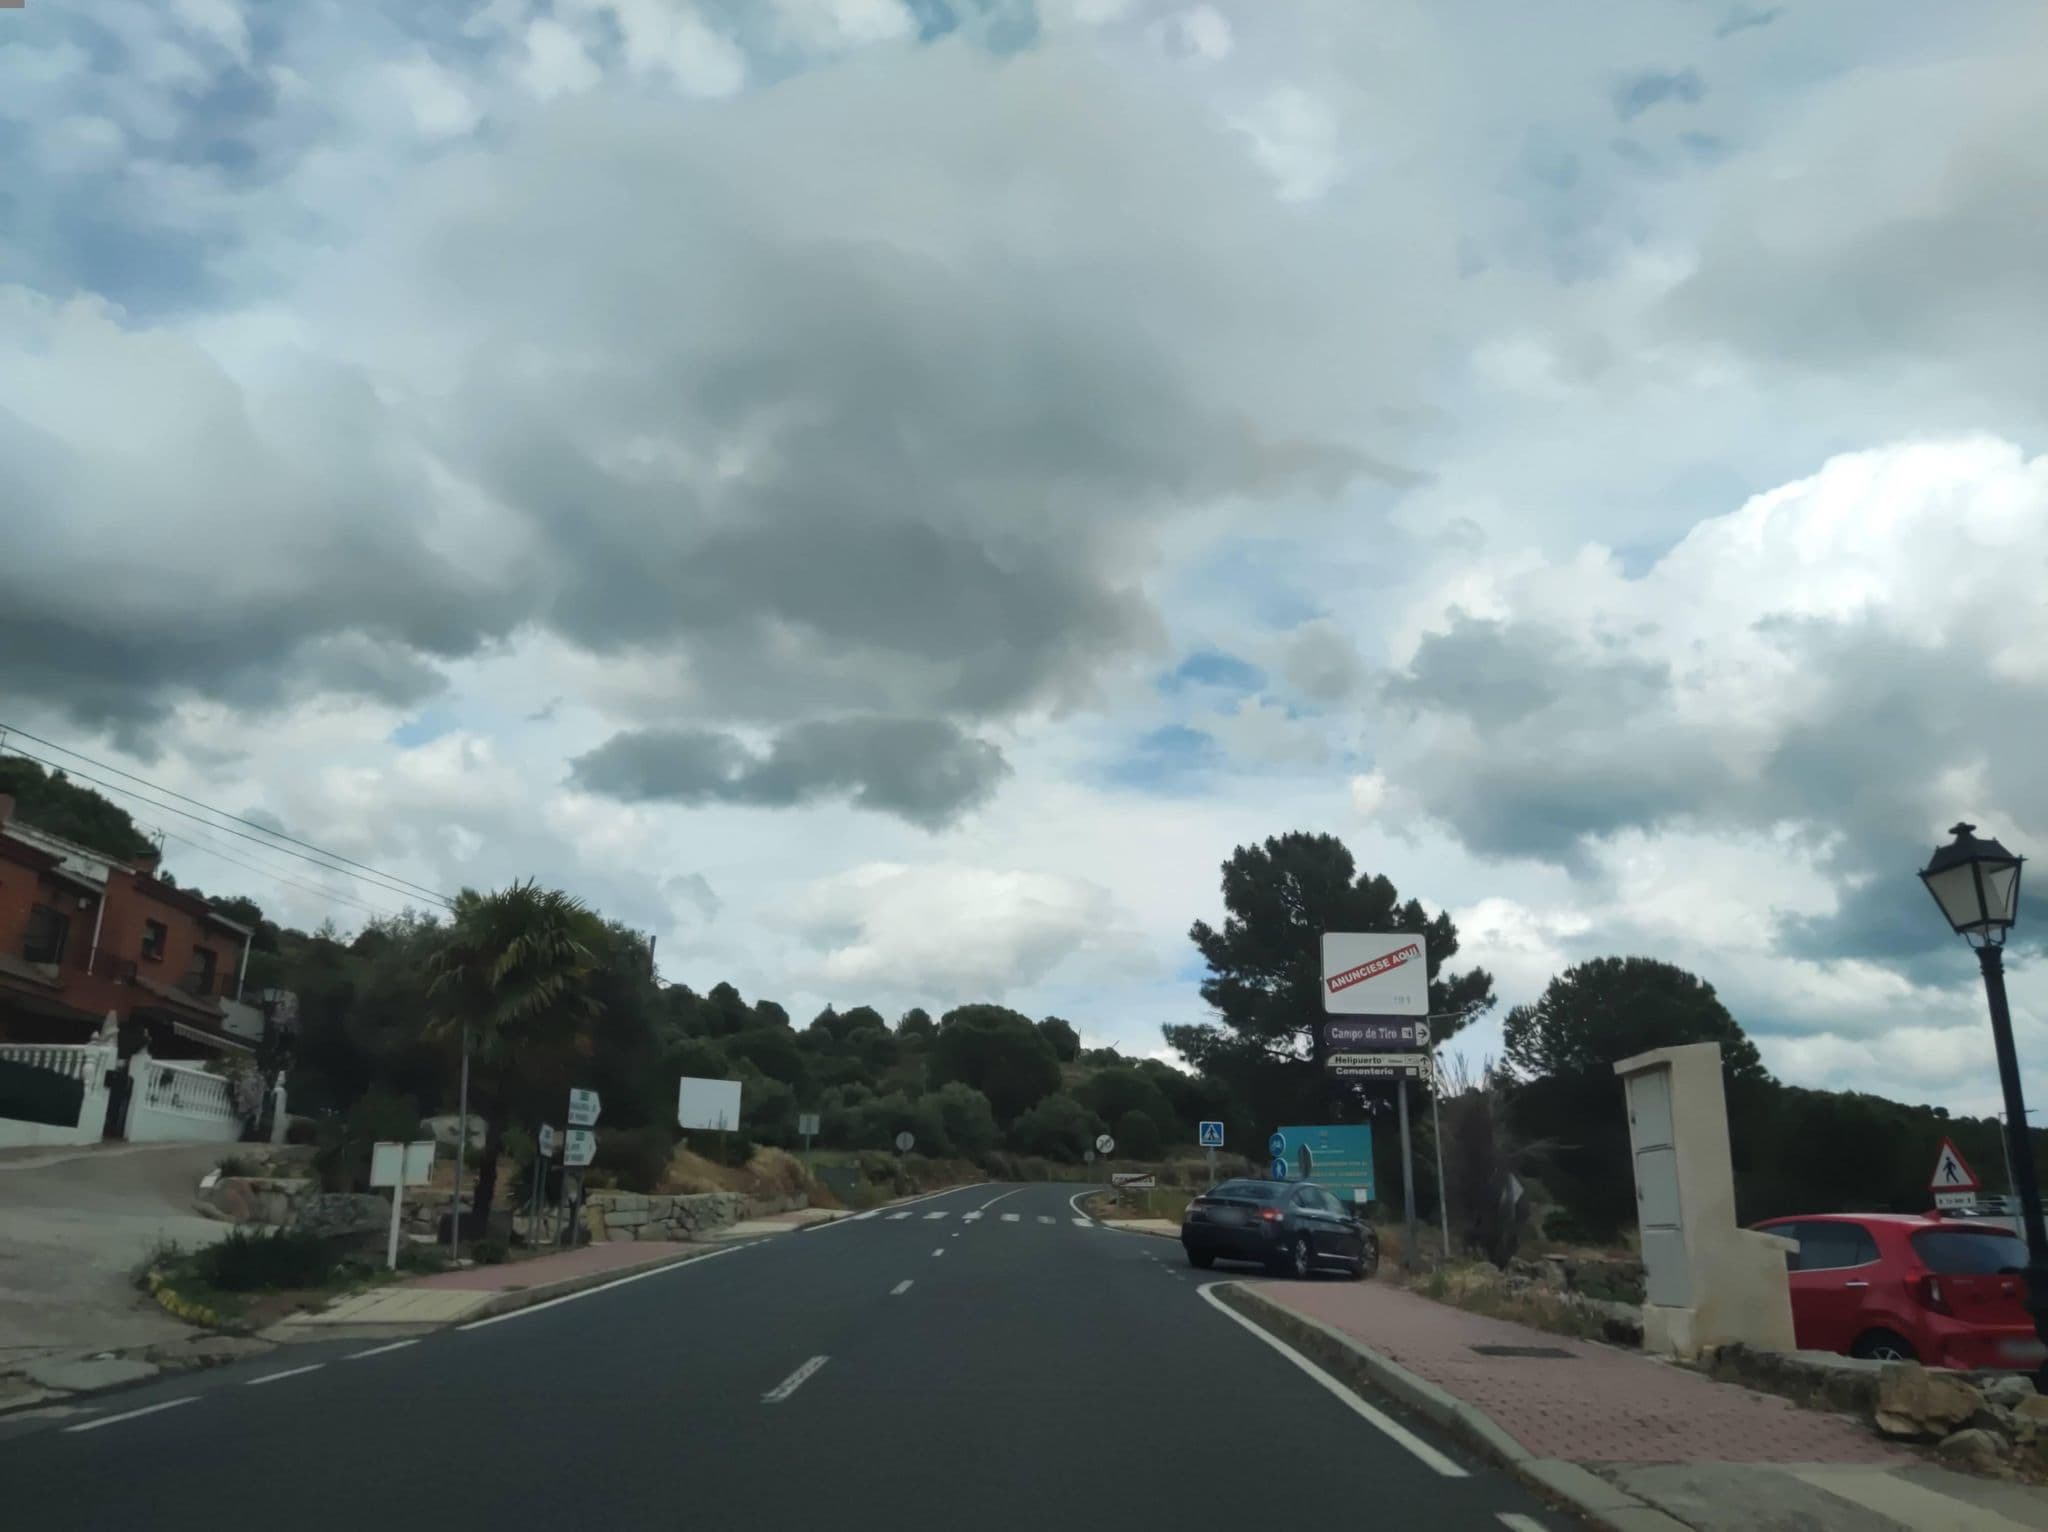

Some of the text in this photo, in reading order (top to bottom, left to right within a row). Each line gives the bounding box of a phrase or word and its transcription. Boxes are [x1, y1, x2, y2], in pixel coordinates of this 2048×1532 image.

[1331, 958, 1391, 989] ANUNCIESE
[1331, 1027, 1398, 1041] Campo de Tiro
[1335, 1056, 1382, 1065] Helipuerto
